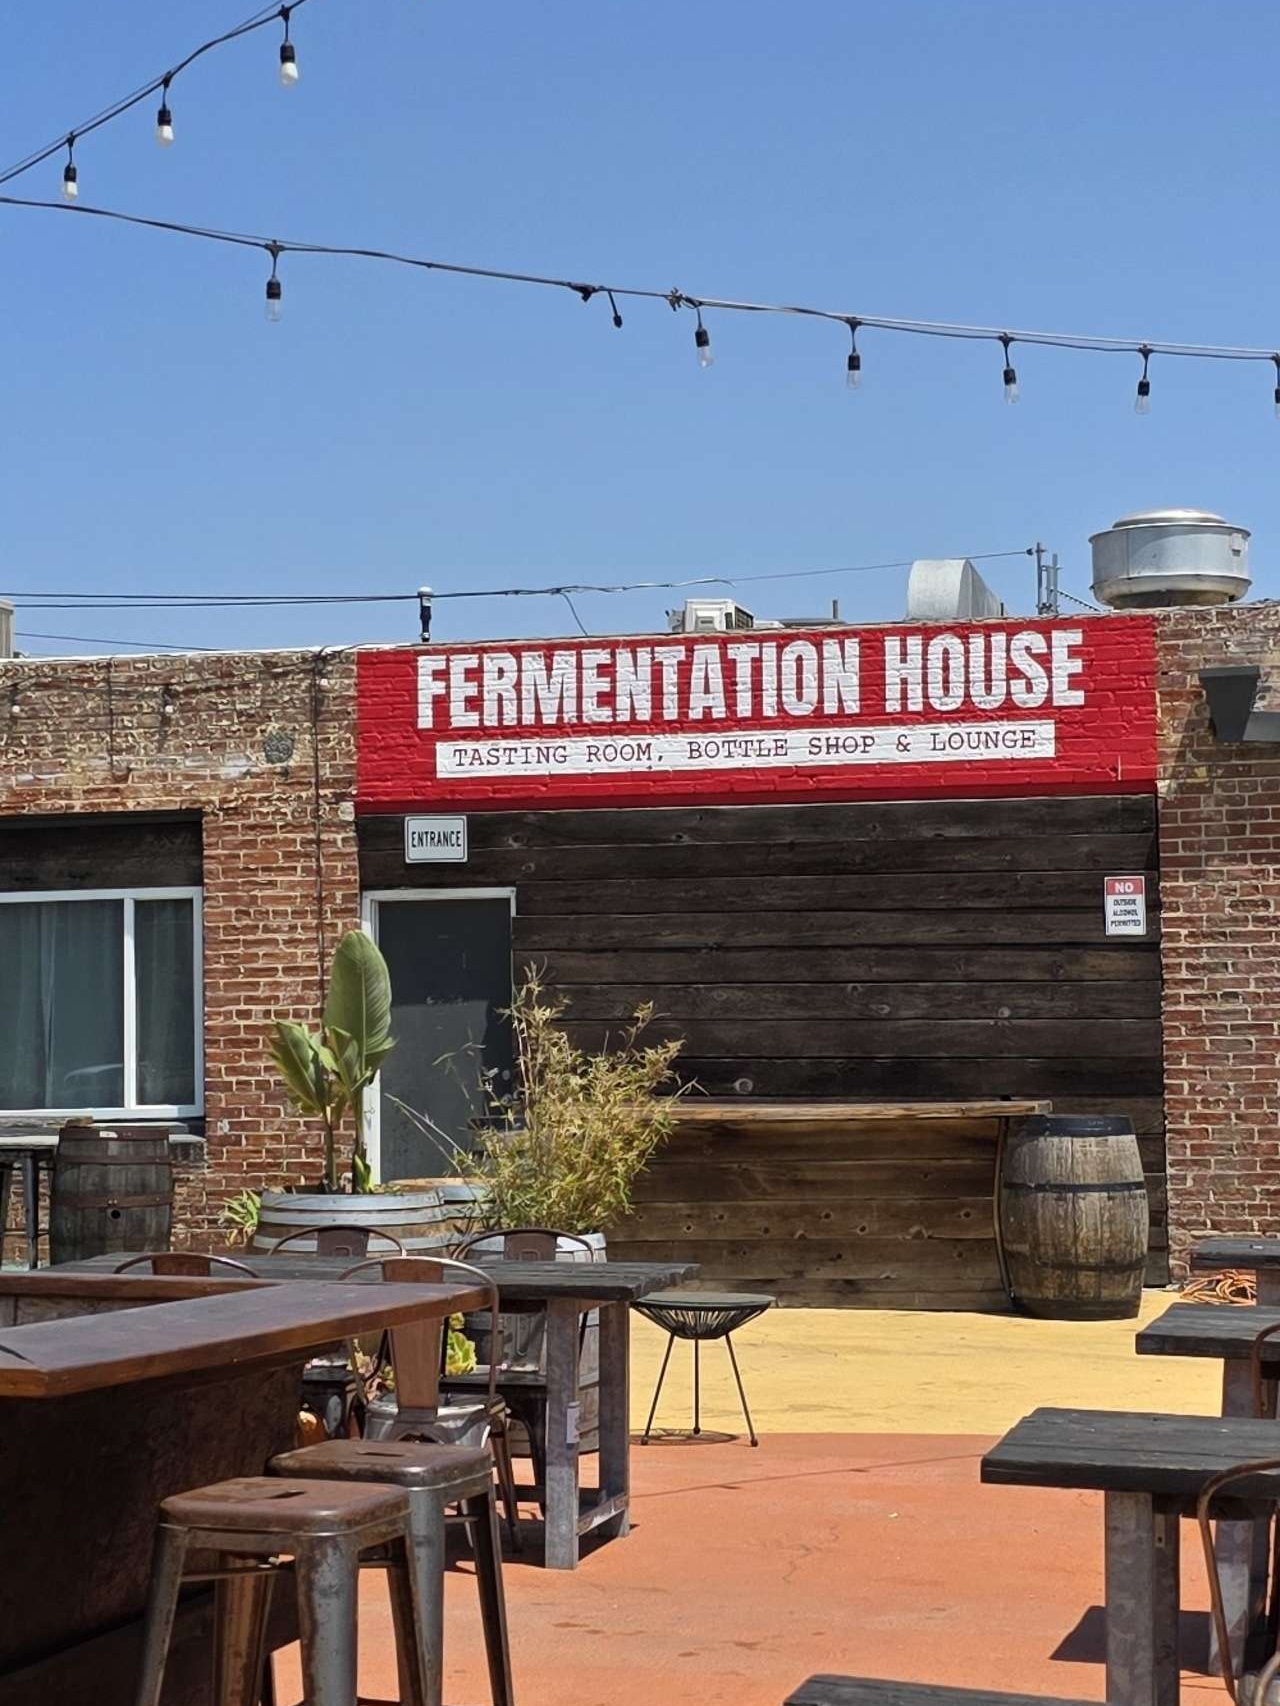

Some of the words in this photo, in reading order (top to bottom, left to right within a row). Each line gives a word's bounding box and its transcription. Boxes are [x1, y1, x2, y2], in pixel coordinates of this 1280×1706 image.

[417, 638, 861, 729] FERMENTATION
[885, 629, 1085, 712] HOUSE
[453, 745, 568, 767] TASTING
[586, 742, 665, 763] ROOM,
[688, 738, 788, 760] BOTTLE
[808, 735, 876, 756] SHOP
[896, 733, 912, 753] &
[930, 729, 1037, 752] LOUNGE
[411, 830, 462, 848] ENTRANCE
[1114, 881, 1134, 894] NO
